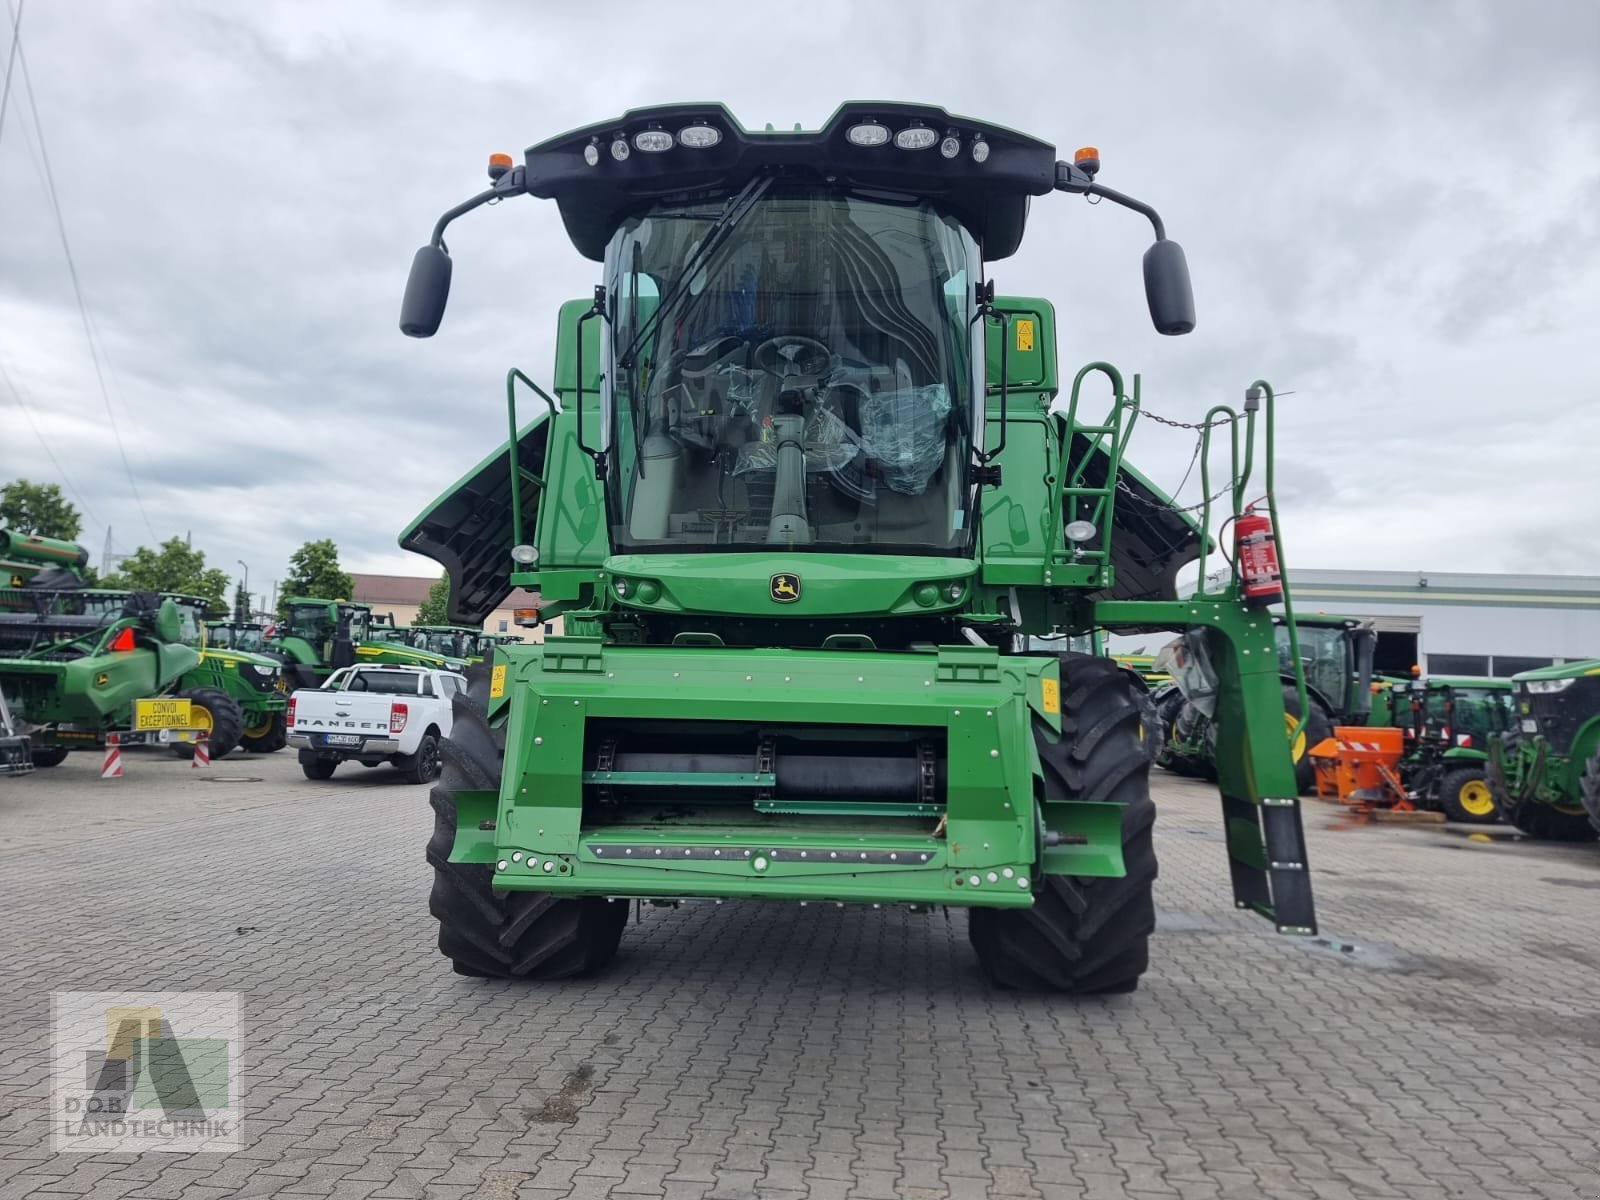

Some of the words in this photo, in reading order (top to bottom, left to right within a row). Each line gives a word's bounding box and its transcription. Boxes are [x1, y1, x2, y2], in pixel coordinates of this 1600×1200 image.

[152, 702, 177, 714] CONVOI
[140, 713, 188, 727] EXCEPTIONNEL
[297, 719, 388, 730] RANGER
